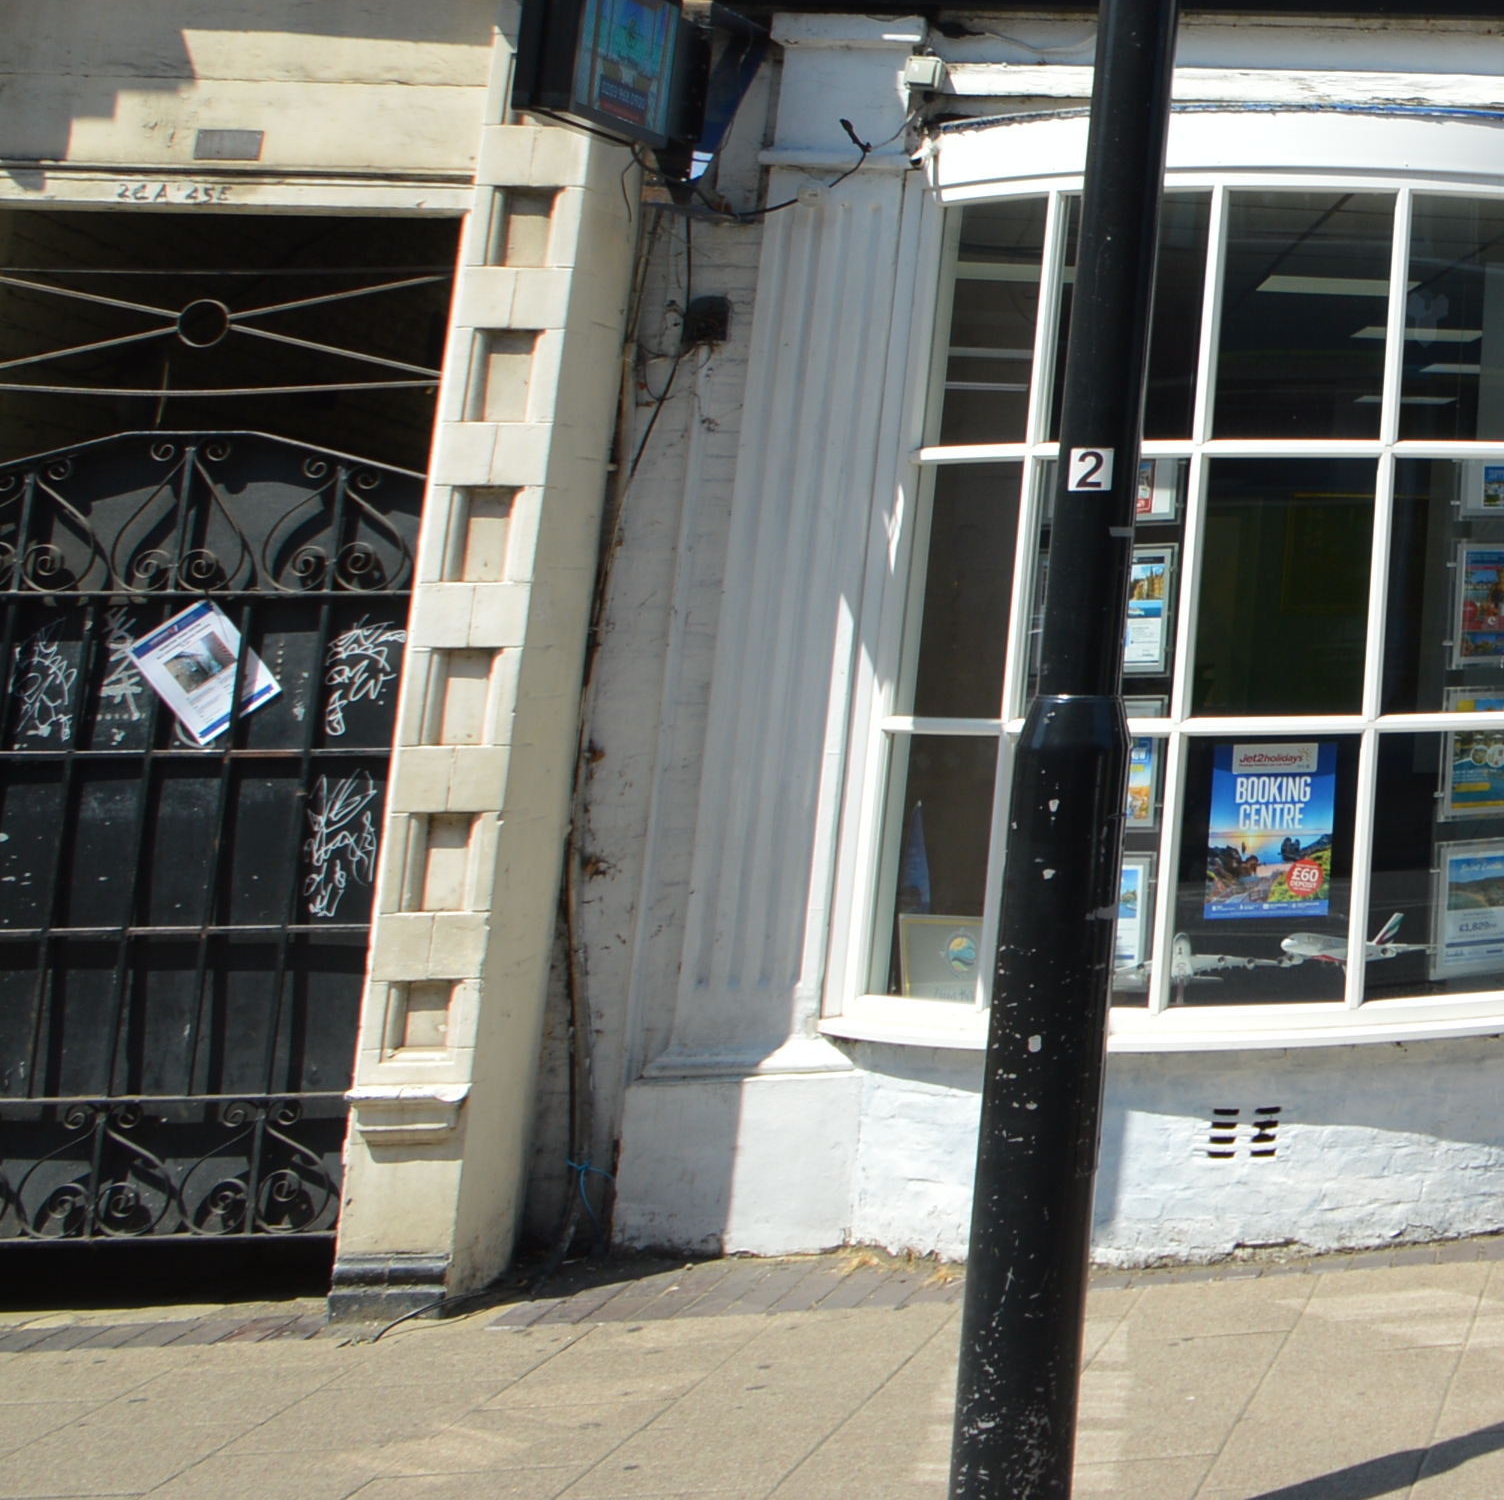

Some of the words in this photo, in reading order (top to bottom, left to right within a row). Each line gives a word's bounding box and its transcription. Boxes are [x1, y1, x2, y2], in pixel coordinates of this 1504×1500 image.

[1074, 451, 1105, 490] 2
[1235, 775, 1312, 804] BOOKING
[1239, 802, 1305, 830] CENTRE
[1289, 880, 1318, 890] DEPOSIT
[1291, 866, 1320, 883] £60
